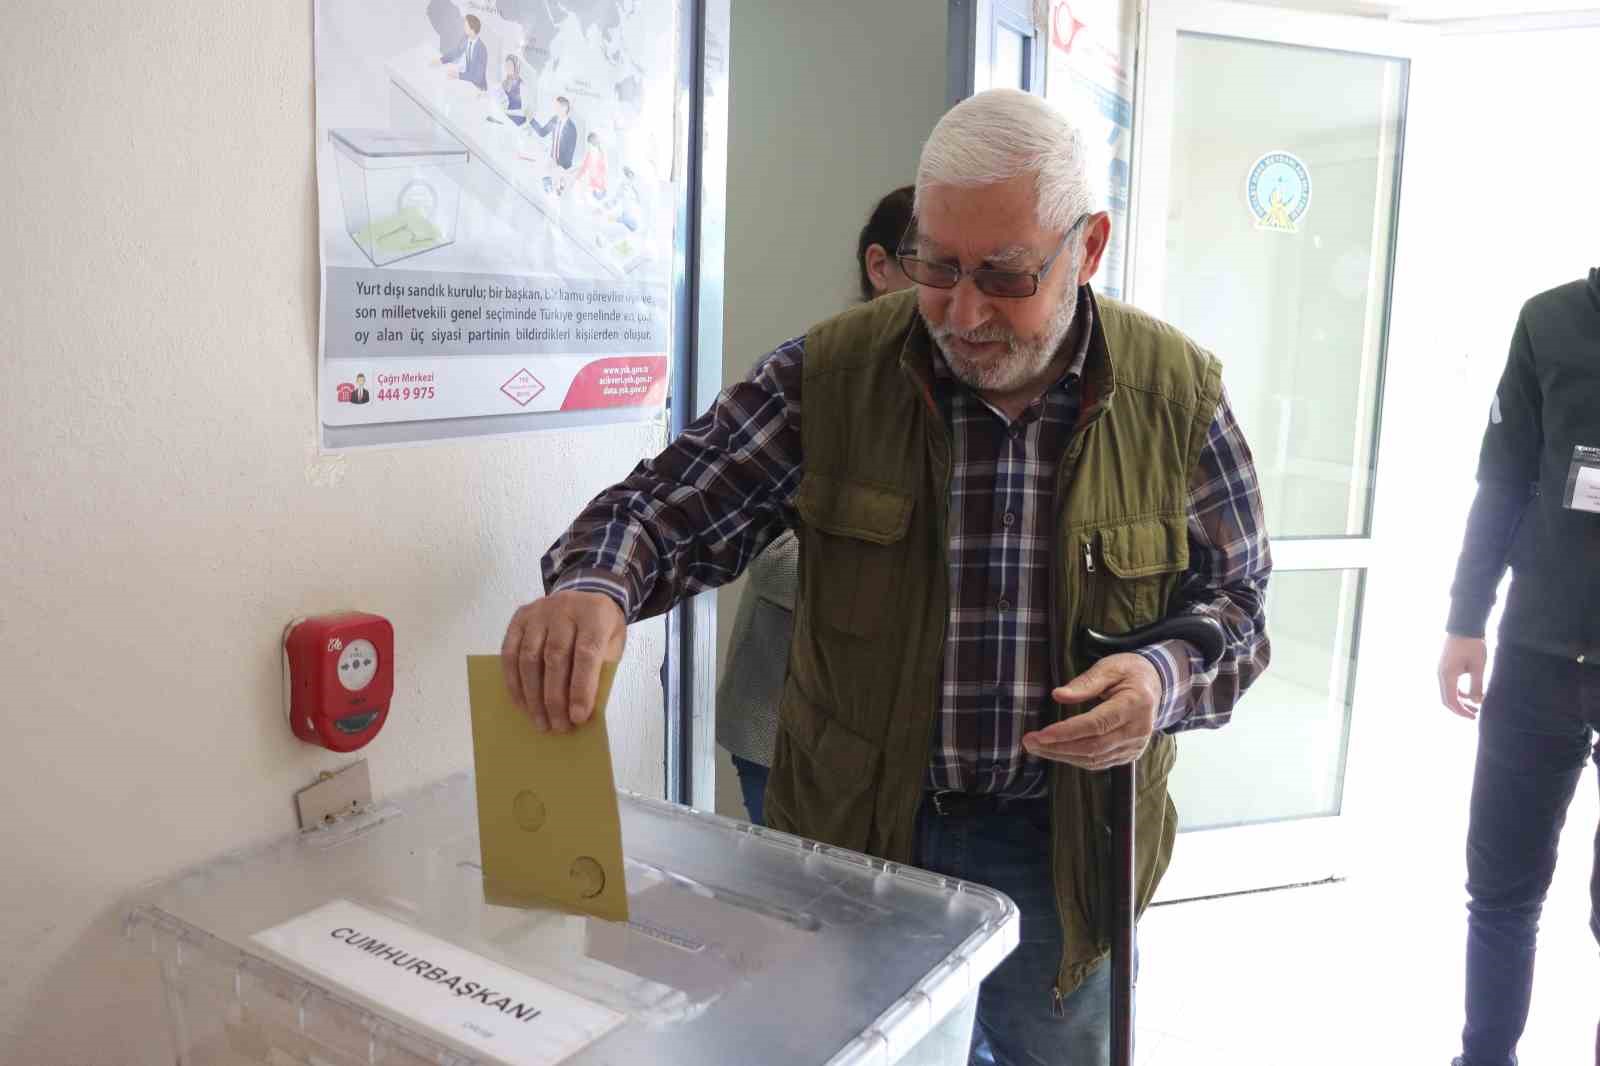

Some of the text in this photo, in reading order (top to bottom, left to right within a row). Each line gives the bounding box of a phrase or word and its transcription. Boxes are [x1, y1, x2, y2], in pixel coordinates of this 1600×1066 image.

[356, 281, 381, 297] Yurt
[384, 282, 405, 300] dışı
[407, 284, 445, 298] sandık
[447, 284, 487, 300] kurulu;
[489, 285, 503, 299] bir
[560, 288, 584, 302] kamu
[355, 306, 376, 319] son
[382, 305, 446, 320] milletvekili
[450, 306, 482, 323] genel
[486, 307, 537, 323] seçiminde
[540, 308, 573, 323] Türkiye
[576, 309, 621, 324] genelinde
[354, 327, 652, 345] oy alan üç siyasi partinin bildirdikleri kişilerden oluşur.
[377, 372, 435, 387] Çağrı Merkezi
[377, 386, 436, 401] 444 9 975
[329, 926, 542, 1023] CUMHURBAŞKANI
